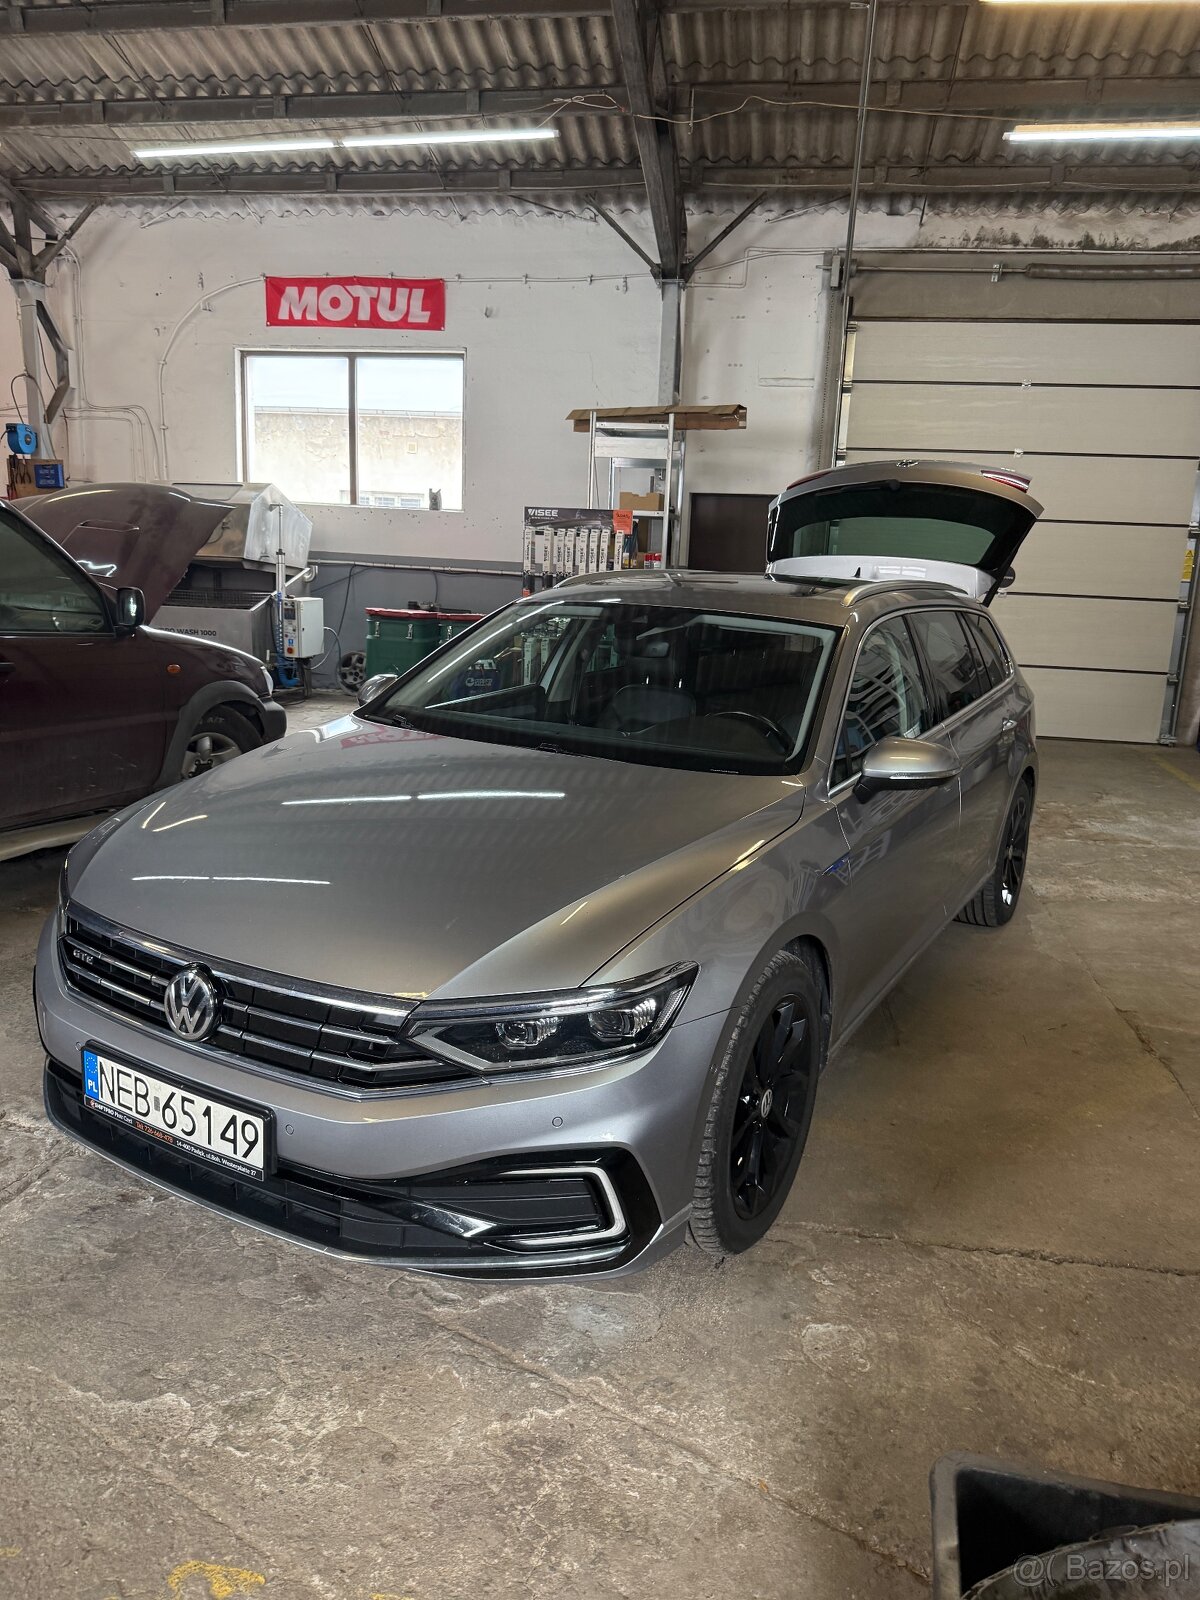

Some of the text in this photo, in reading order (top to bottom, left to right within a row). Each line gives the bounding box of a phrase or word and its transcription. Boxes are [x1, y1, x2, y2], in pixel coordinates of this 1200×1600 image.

[277, 284, 431, 323] MOTUL
[528, 508, 559, 517] VISEE
[176, 628, 199, 636] WASH
[200, 629, 217, 637] 1000
[87, 1079, 98, 1093] PL
[98, 1061, 259, 1159] NEB 65149
